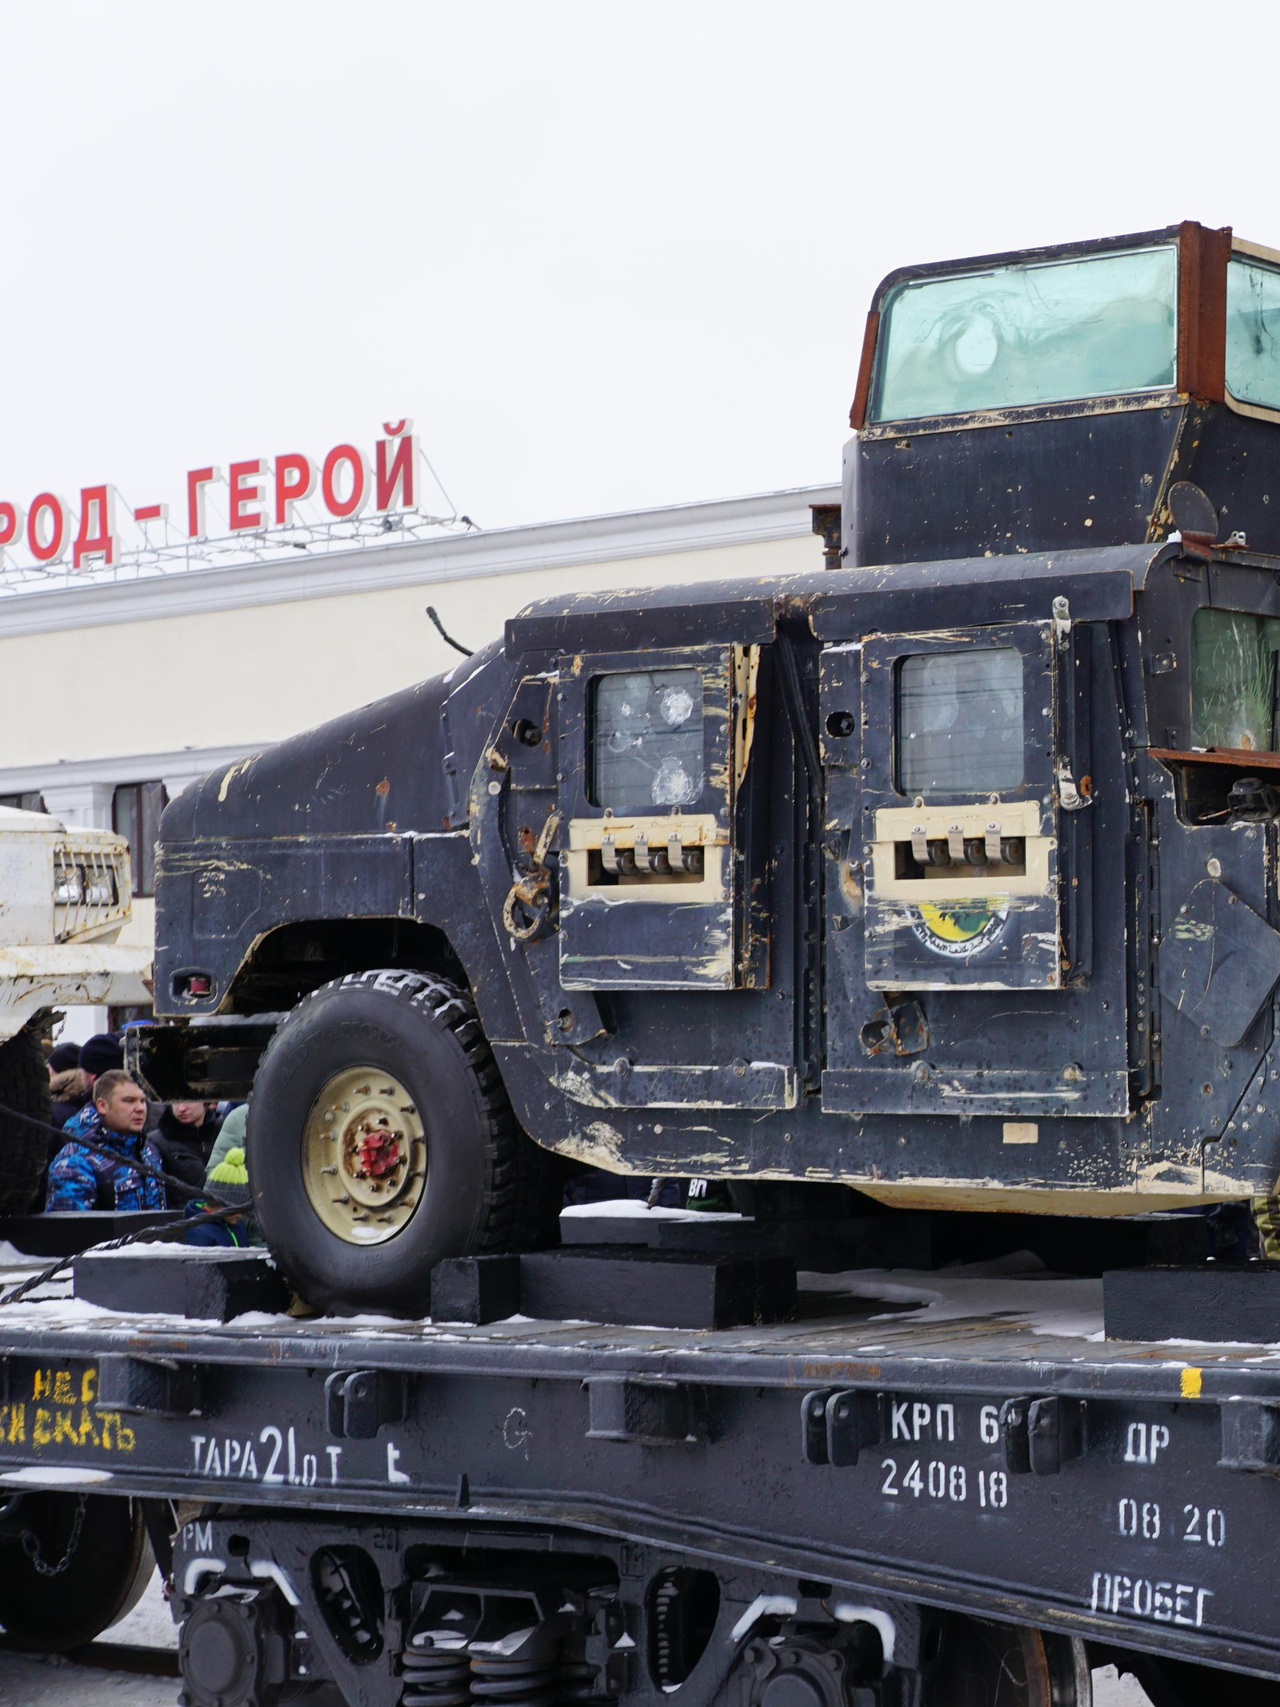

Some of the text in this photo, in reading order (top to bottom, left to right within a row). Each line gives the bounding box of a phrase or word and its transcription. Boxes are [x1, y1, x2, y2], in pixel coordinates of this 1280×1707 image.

[33, 1369, 76, 1404] НЕ
[892, 1402, 955, 1442] КРП
[1124, 1422, 1170, 1464] ДР
[191, 1435, 258, 1480] ТАРА
[1092, 1571, 1215, 1627] ПРОБЕГ
